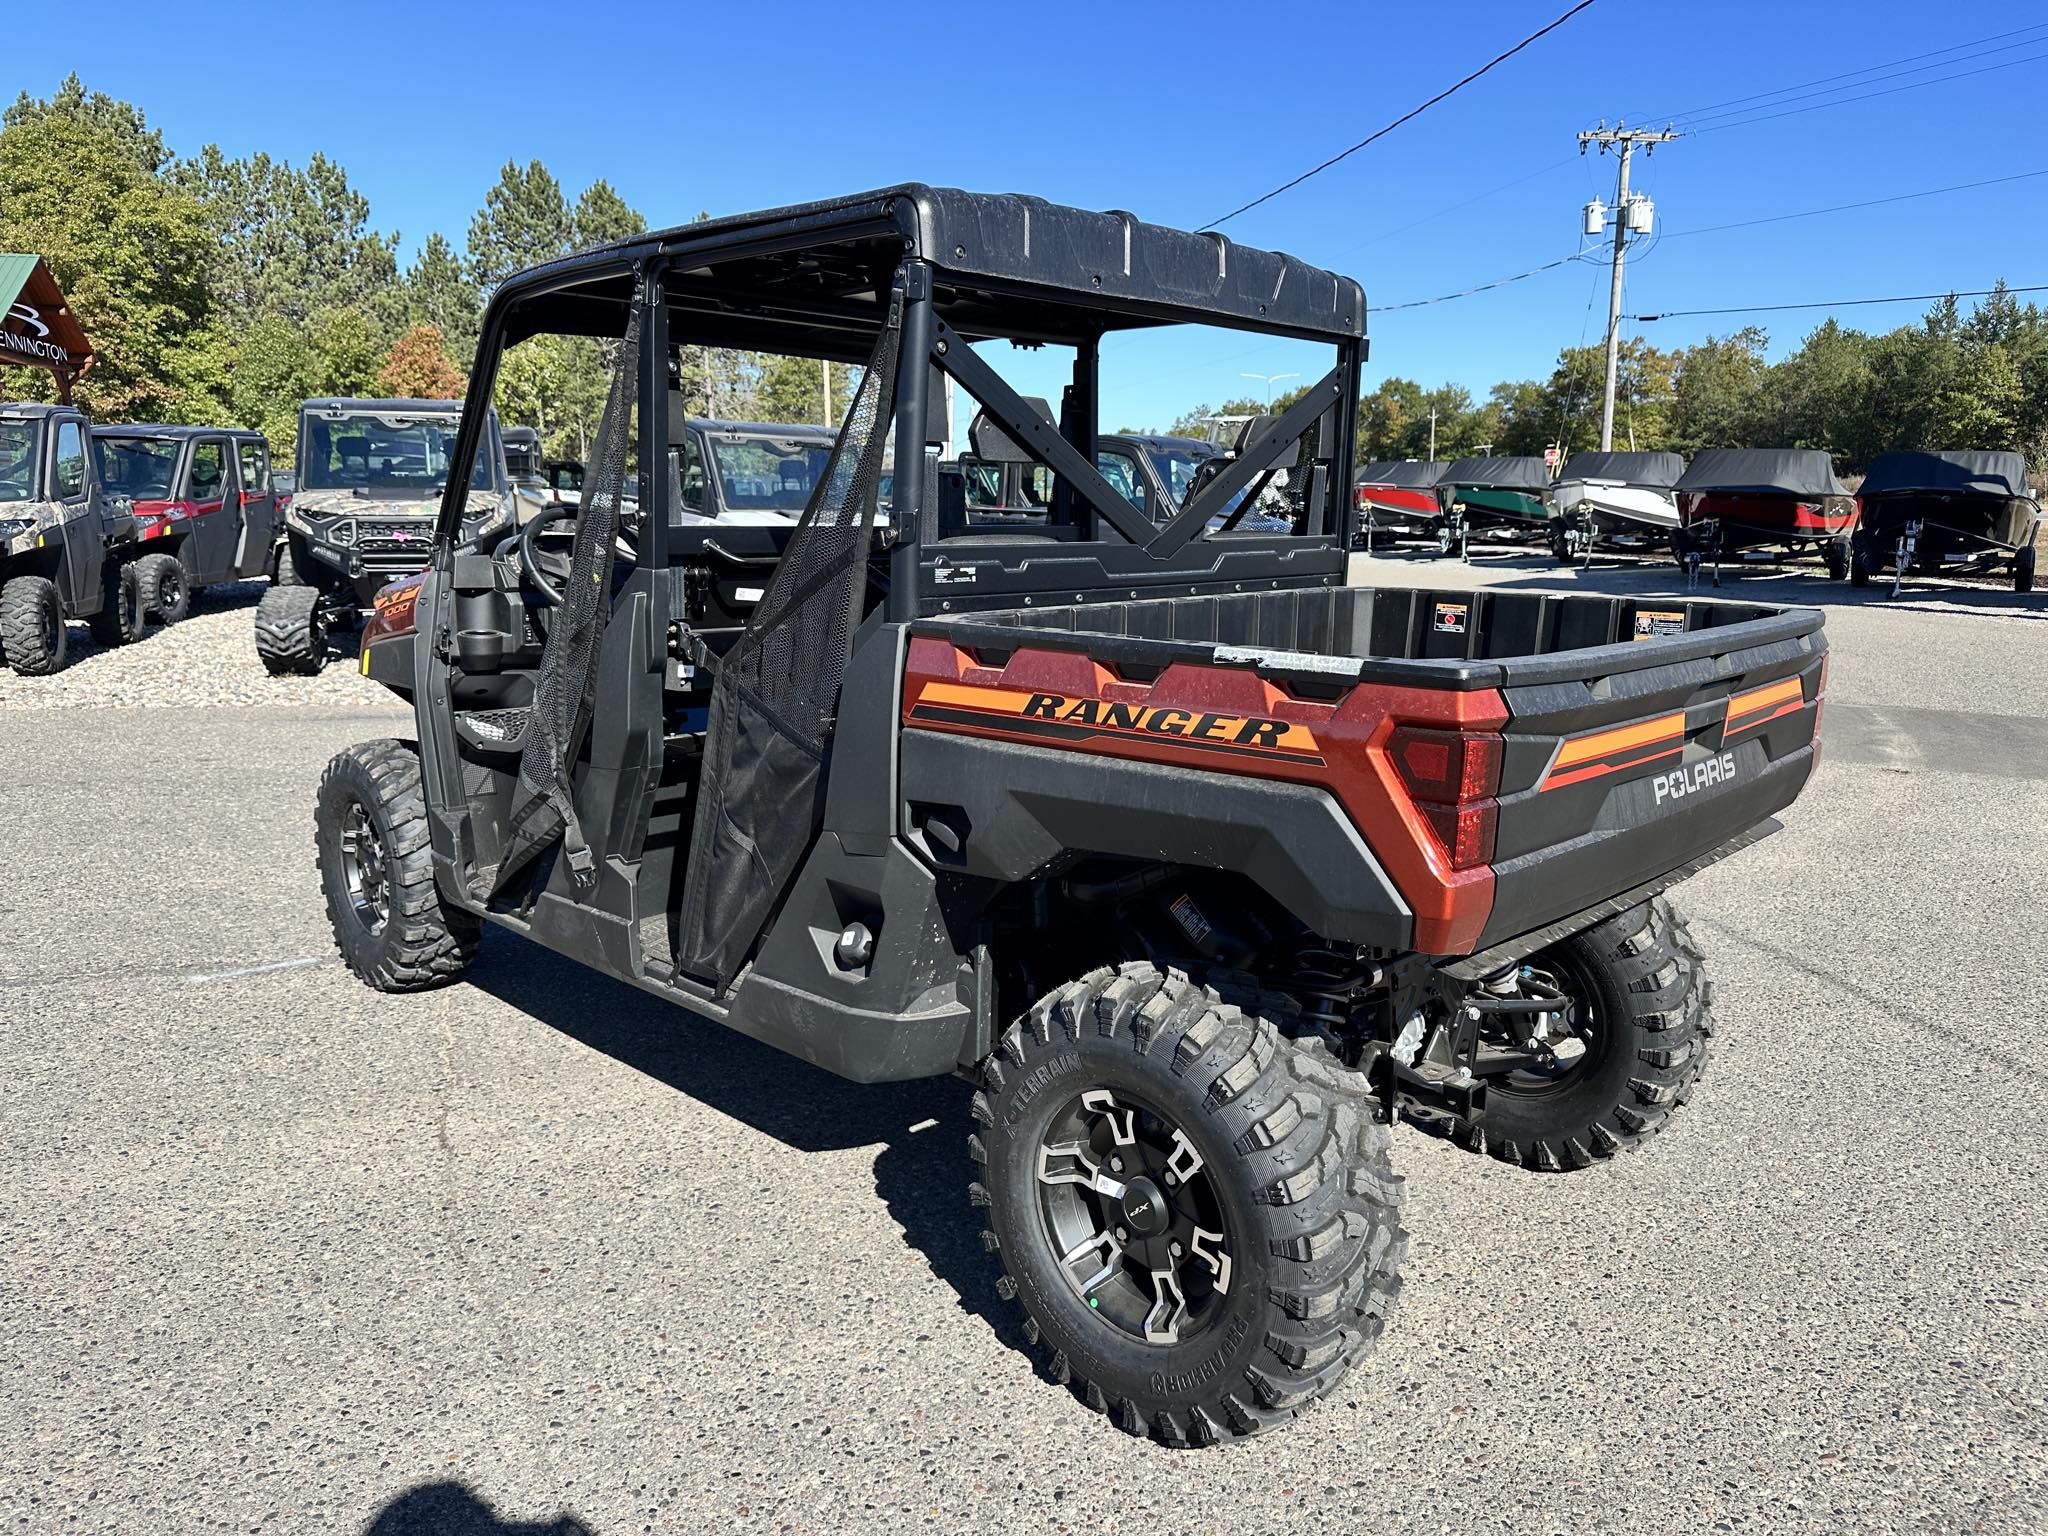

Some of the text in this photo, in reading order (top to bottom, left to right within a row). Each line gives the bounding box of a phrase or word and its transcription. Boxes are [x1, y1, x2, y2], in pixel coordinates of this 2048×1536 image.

[384, 602, 410, 618] 1000
[1020, 692, 1291, 748] RANGER
[1652, 752, 1736, 805] POLARIS
